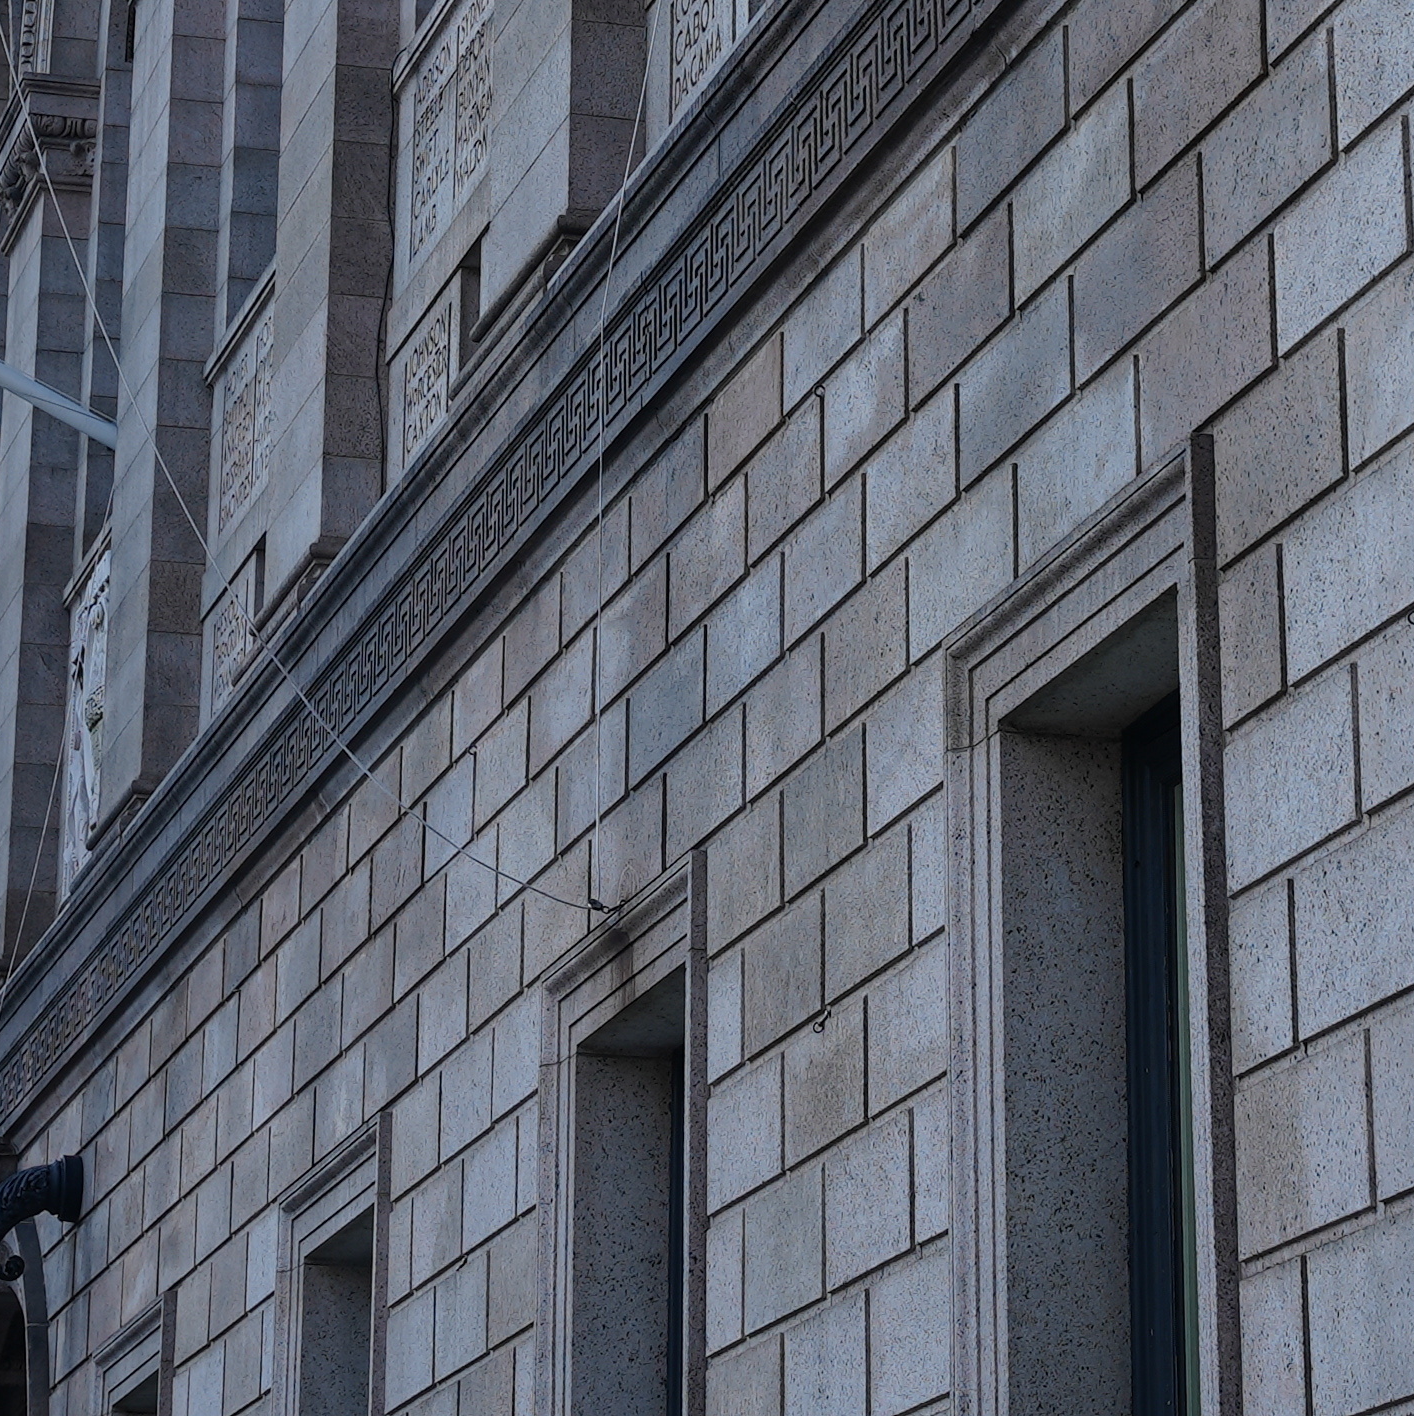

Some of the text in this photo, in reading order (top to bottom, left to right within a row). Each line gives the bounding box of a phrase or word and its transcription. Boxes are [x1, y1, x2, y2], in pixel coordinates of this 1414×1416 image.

[417, 35, 452, 104] ADDISON
[414, 149, 449, 219] CARLYLE
[415, 129, 438, 183] SWIFT
[413, 204, 436, 256] LAMB
[408, 308, 447, 383] JOHNSON
[407, 391, 442, 453] CAXTON
